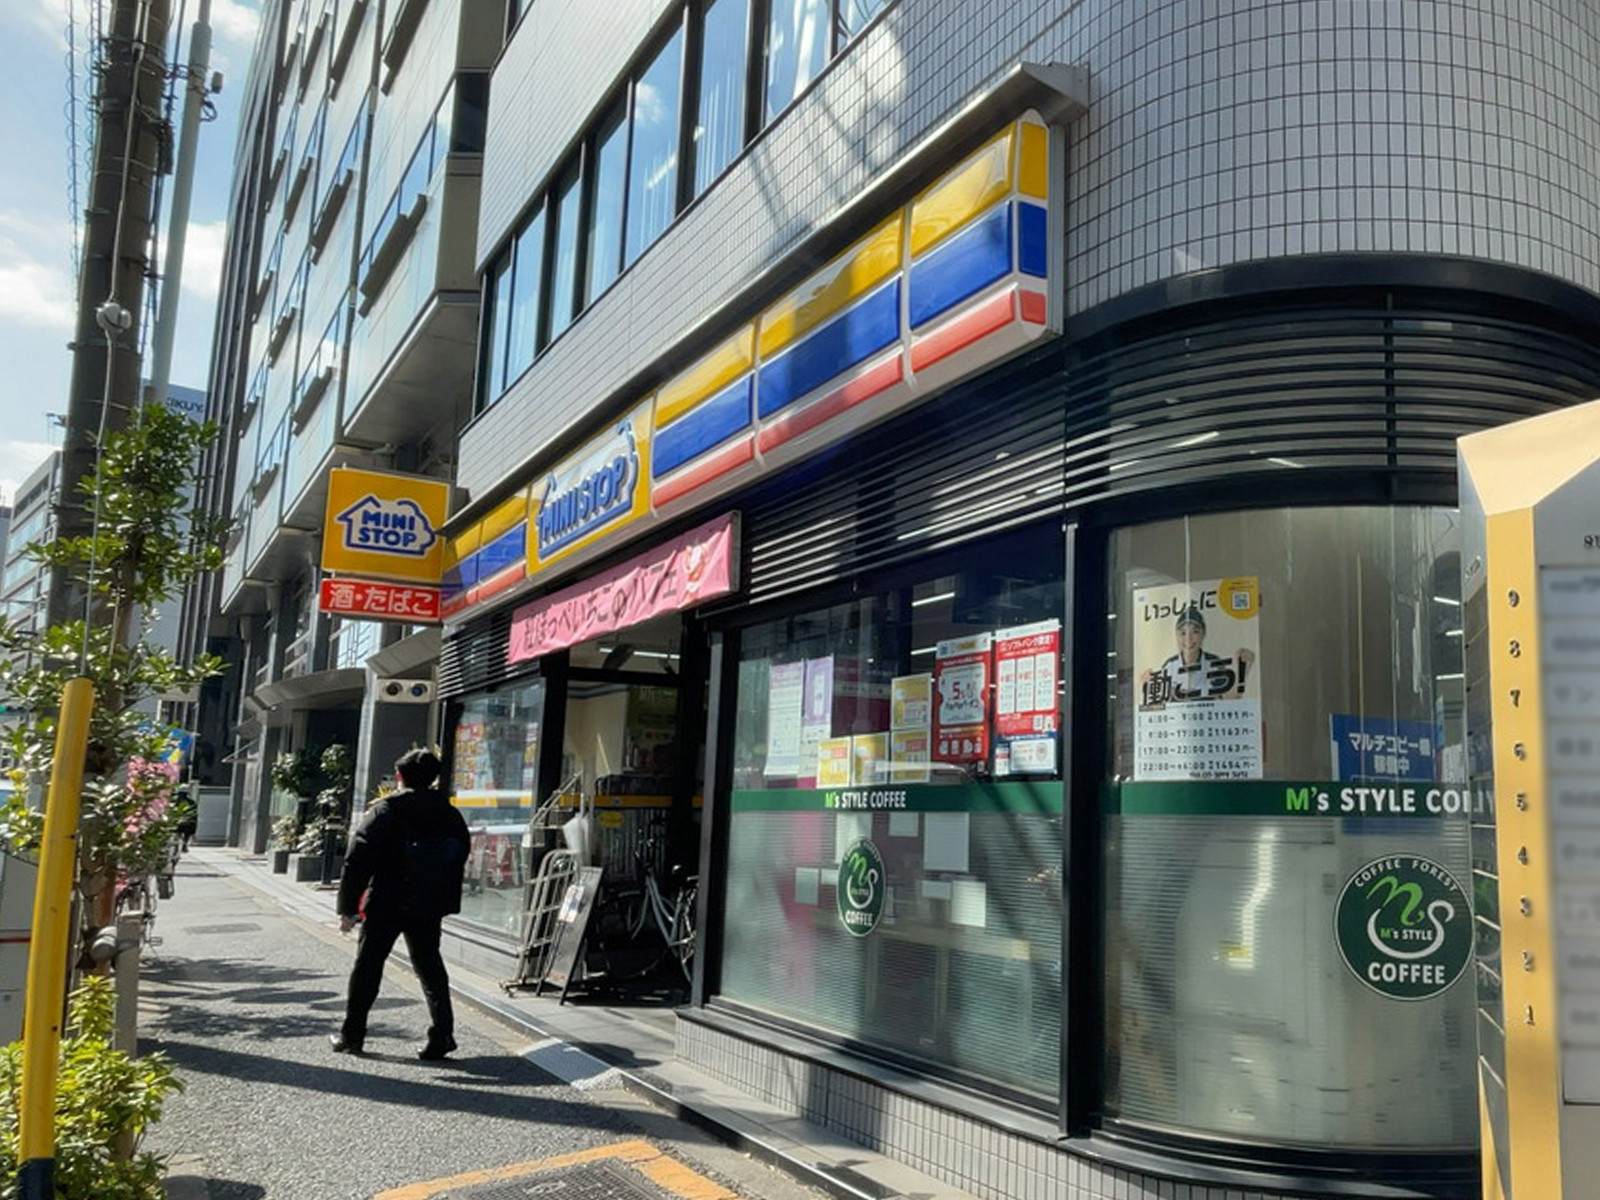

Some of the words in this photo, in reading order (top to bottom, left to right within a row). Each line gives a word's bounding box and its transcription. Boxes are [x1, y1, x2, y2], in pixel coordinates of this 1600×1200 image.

[362, 510, 416, 531] MINI
[358, 527, 417, 547] STOP
[328, 583, 433, 616] 酒・たばこ
[1508, 590, 1520, 608] 9
[1510, 689, 1521, 708] 7
[825, 792, 840, 809] M's
[842, 791, 868, 808] STYLE
[870, 791, 906, 808] COFFEE
[1286, 787, 1330, 812] M's
[1340, 788, 1416, 813] STYLE
[1518, 846, 1529, 865] 4
[1355, 858, 1402, 888] COFFEE
[1411, 859, 1459, 893] FOREST
[845, 910, 873, 927] COFFEE
[1380, 928, 1399, 940] M's
[1402, 929, 1433, 941] STYLE
[1368, 962, 1446, 985] COFFEE
[1525, 1005, 1535, 1026] 1
